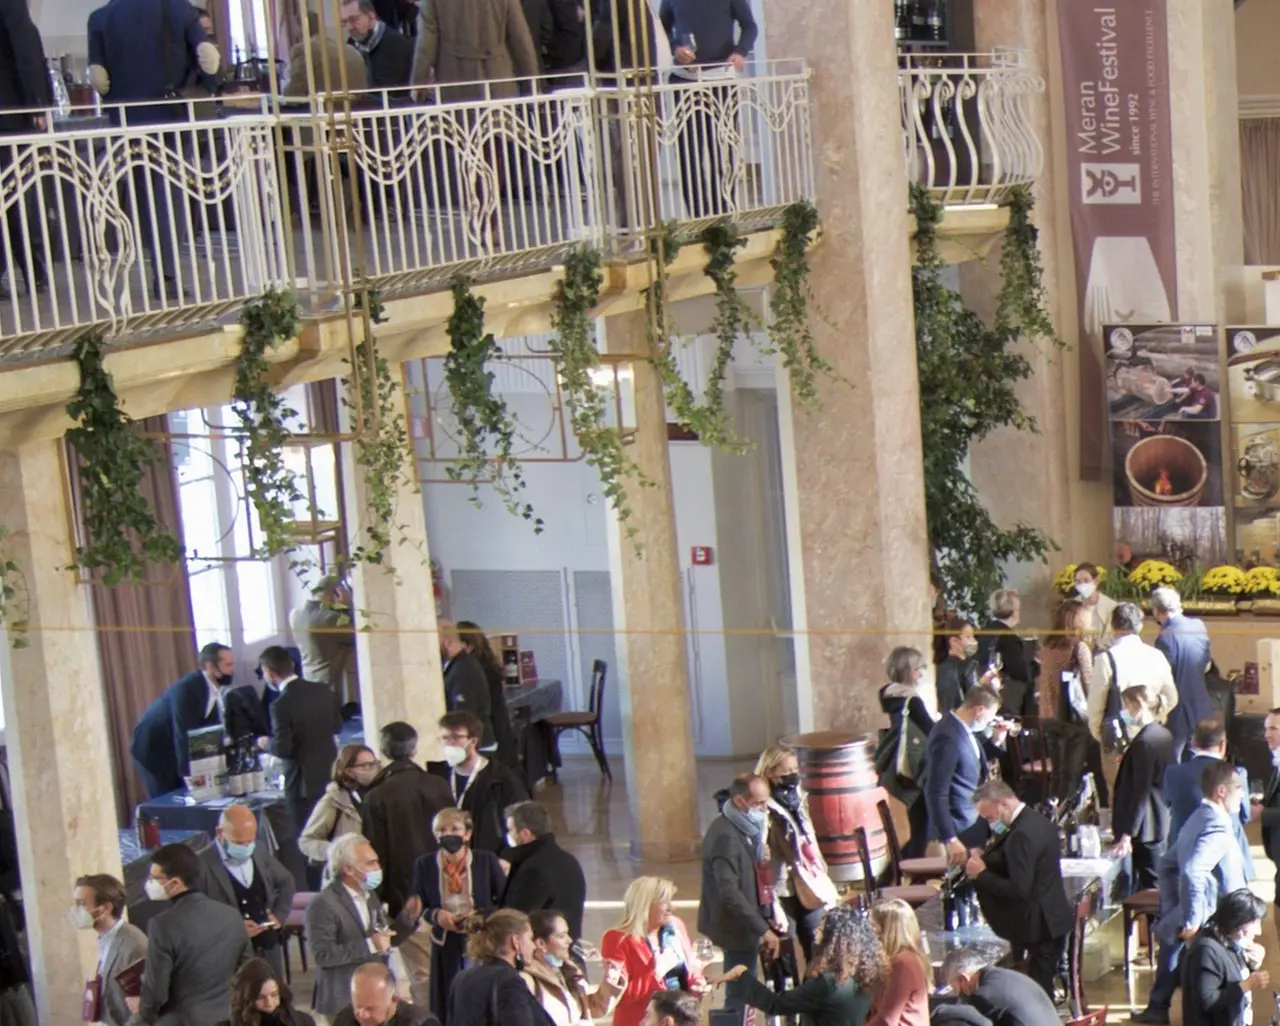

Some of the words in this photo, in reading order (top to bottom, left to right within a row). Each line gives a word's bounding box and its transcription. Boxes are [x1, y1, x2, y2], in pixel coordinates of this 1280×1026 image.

[1093, 7, 1122, 155] WineFestival
[1077, 81, 1098, 154] Meran
[1127, 93, 1140, 122] 1992
[1128, 126, 1141, 156] since
